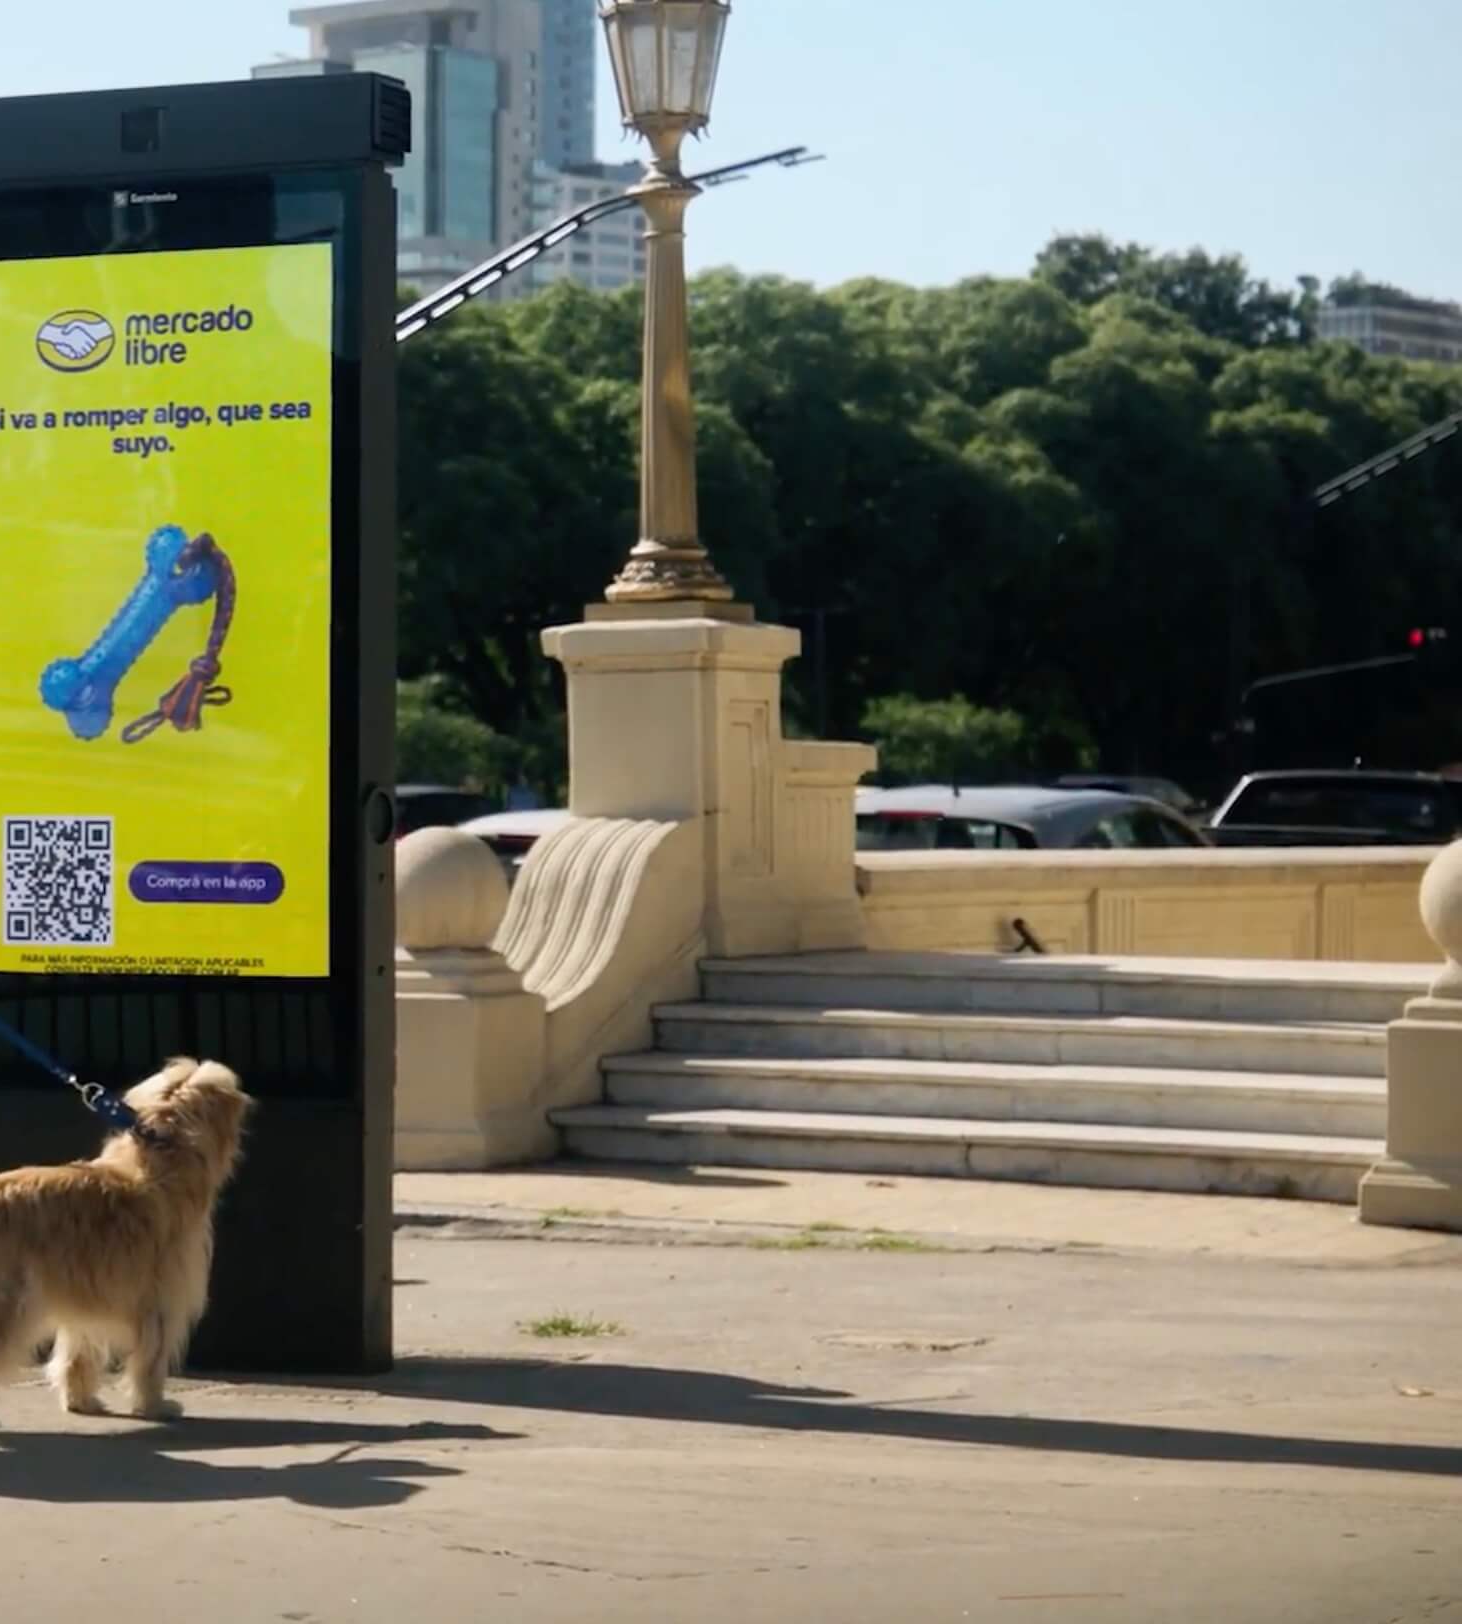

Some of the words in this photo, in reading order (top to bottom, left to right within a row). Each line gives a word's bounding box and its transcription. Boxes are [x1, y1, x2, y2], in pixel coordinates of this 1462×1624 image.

[126, 304, 253, 335] mercado
[126, 339, 187, 365] libre
[10, 413, 37, 429] va
[43, 412, 57, 428] a
[63, 408, 148, 431] romper
[154, 401, 211, 428] algo,
[218, 404, 263, 427] que
[270, 402, 311, 420] sea
[113, 436, 175, 459] suyo.
[203, 879, 220, 889] en
[223, 876, 236, 889] la
[239, 878, 266, 891] app
